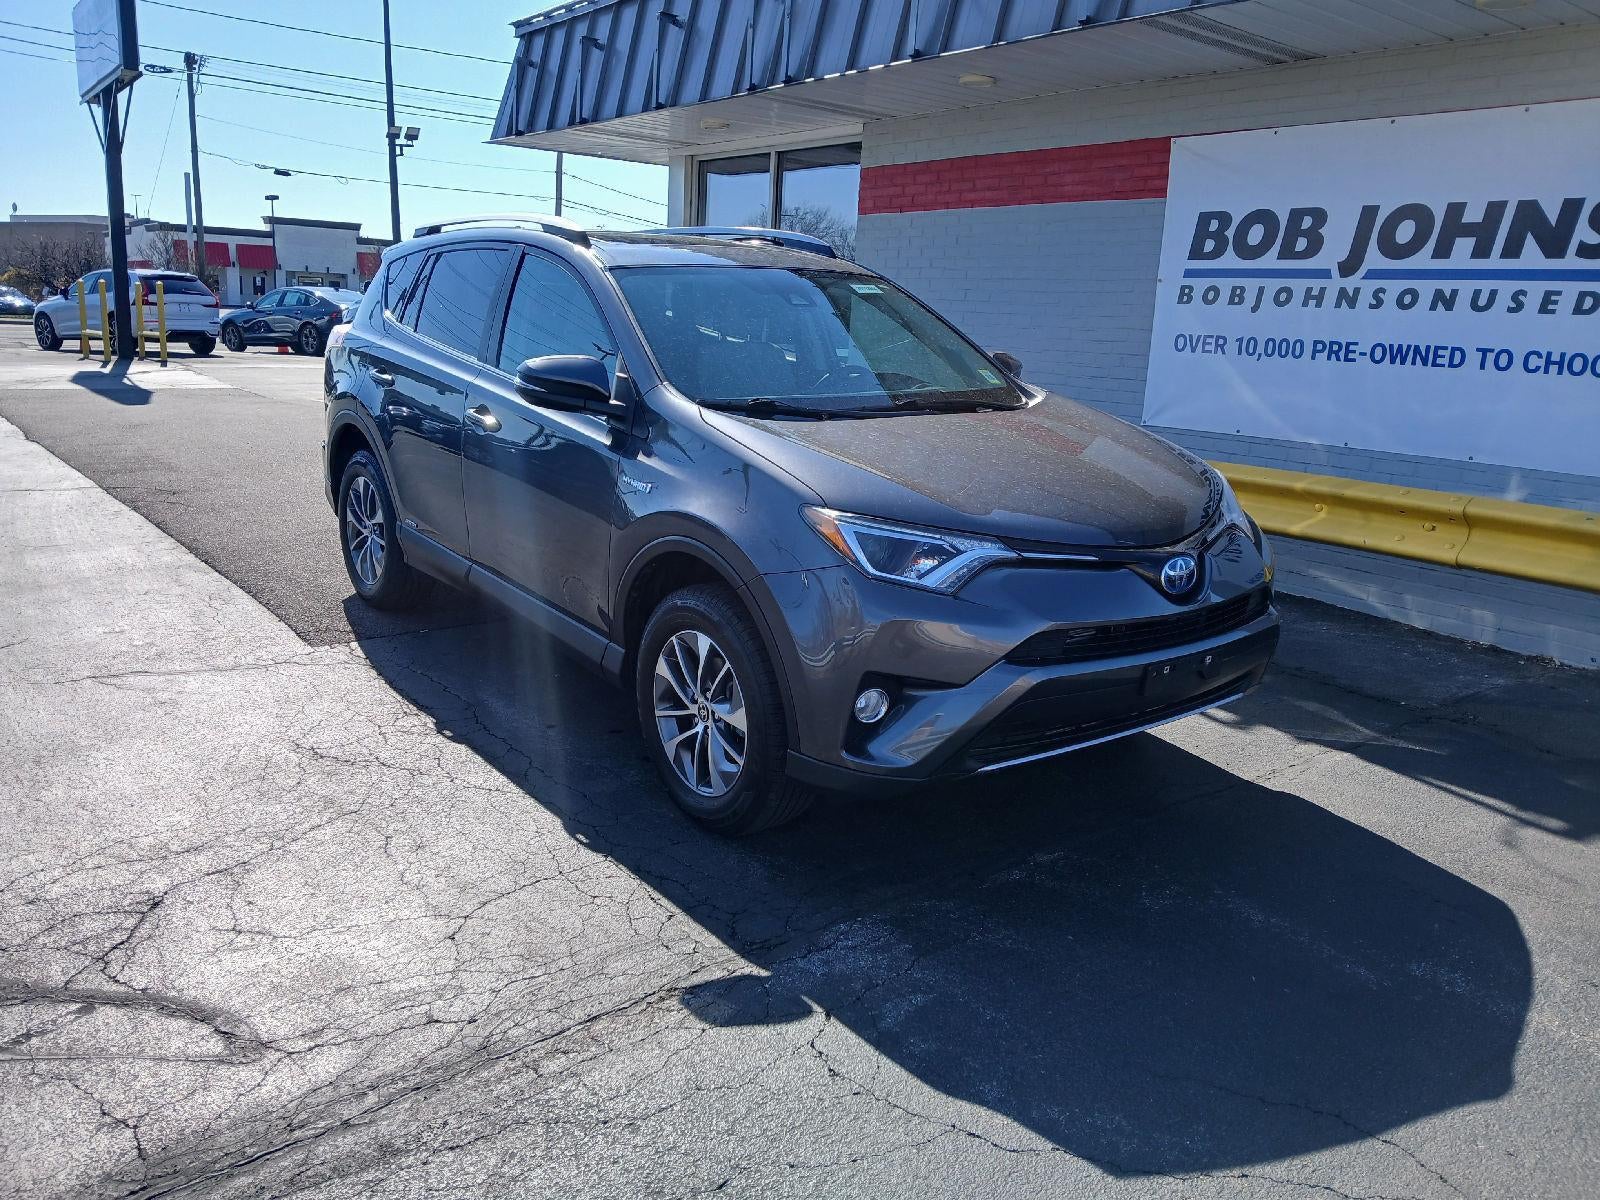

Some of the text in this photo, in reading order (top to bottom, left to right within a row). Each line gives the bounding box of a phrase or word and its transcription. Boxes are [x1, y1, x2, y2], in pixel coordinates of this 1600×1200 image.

[1187, 207, 1328, 260] BOB
[1176, 284, 1600, 316] BOBJOHNSONUSED
[1173, 333, 1228, 355] OVER
[1235, 335, 1305, 362] 10,000
[1310, 339, 1467, 369] PRE-OWNED
[1476, 347, 1514, 372] TO
